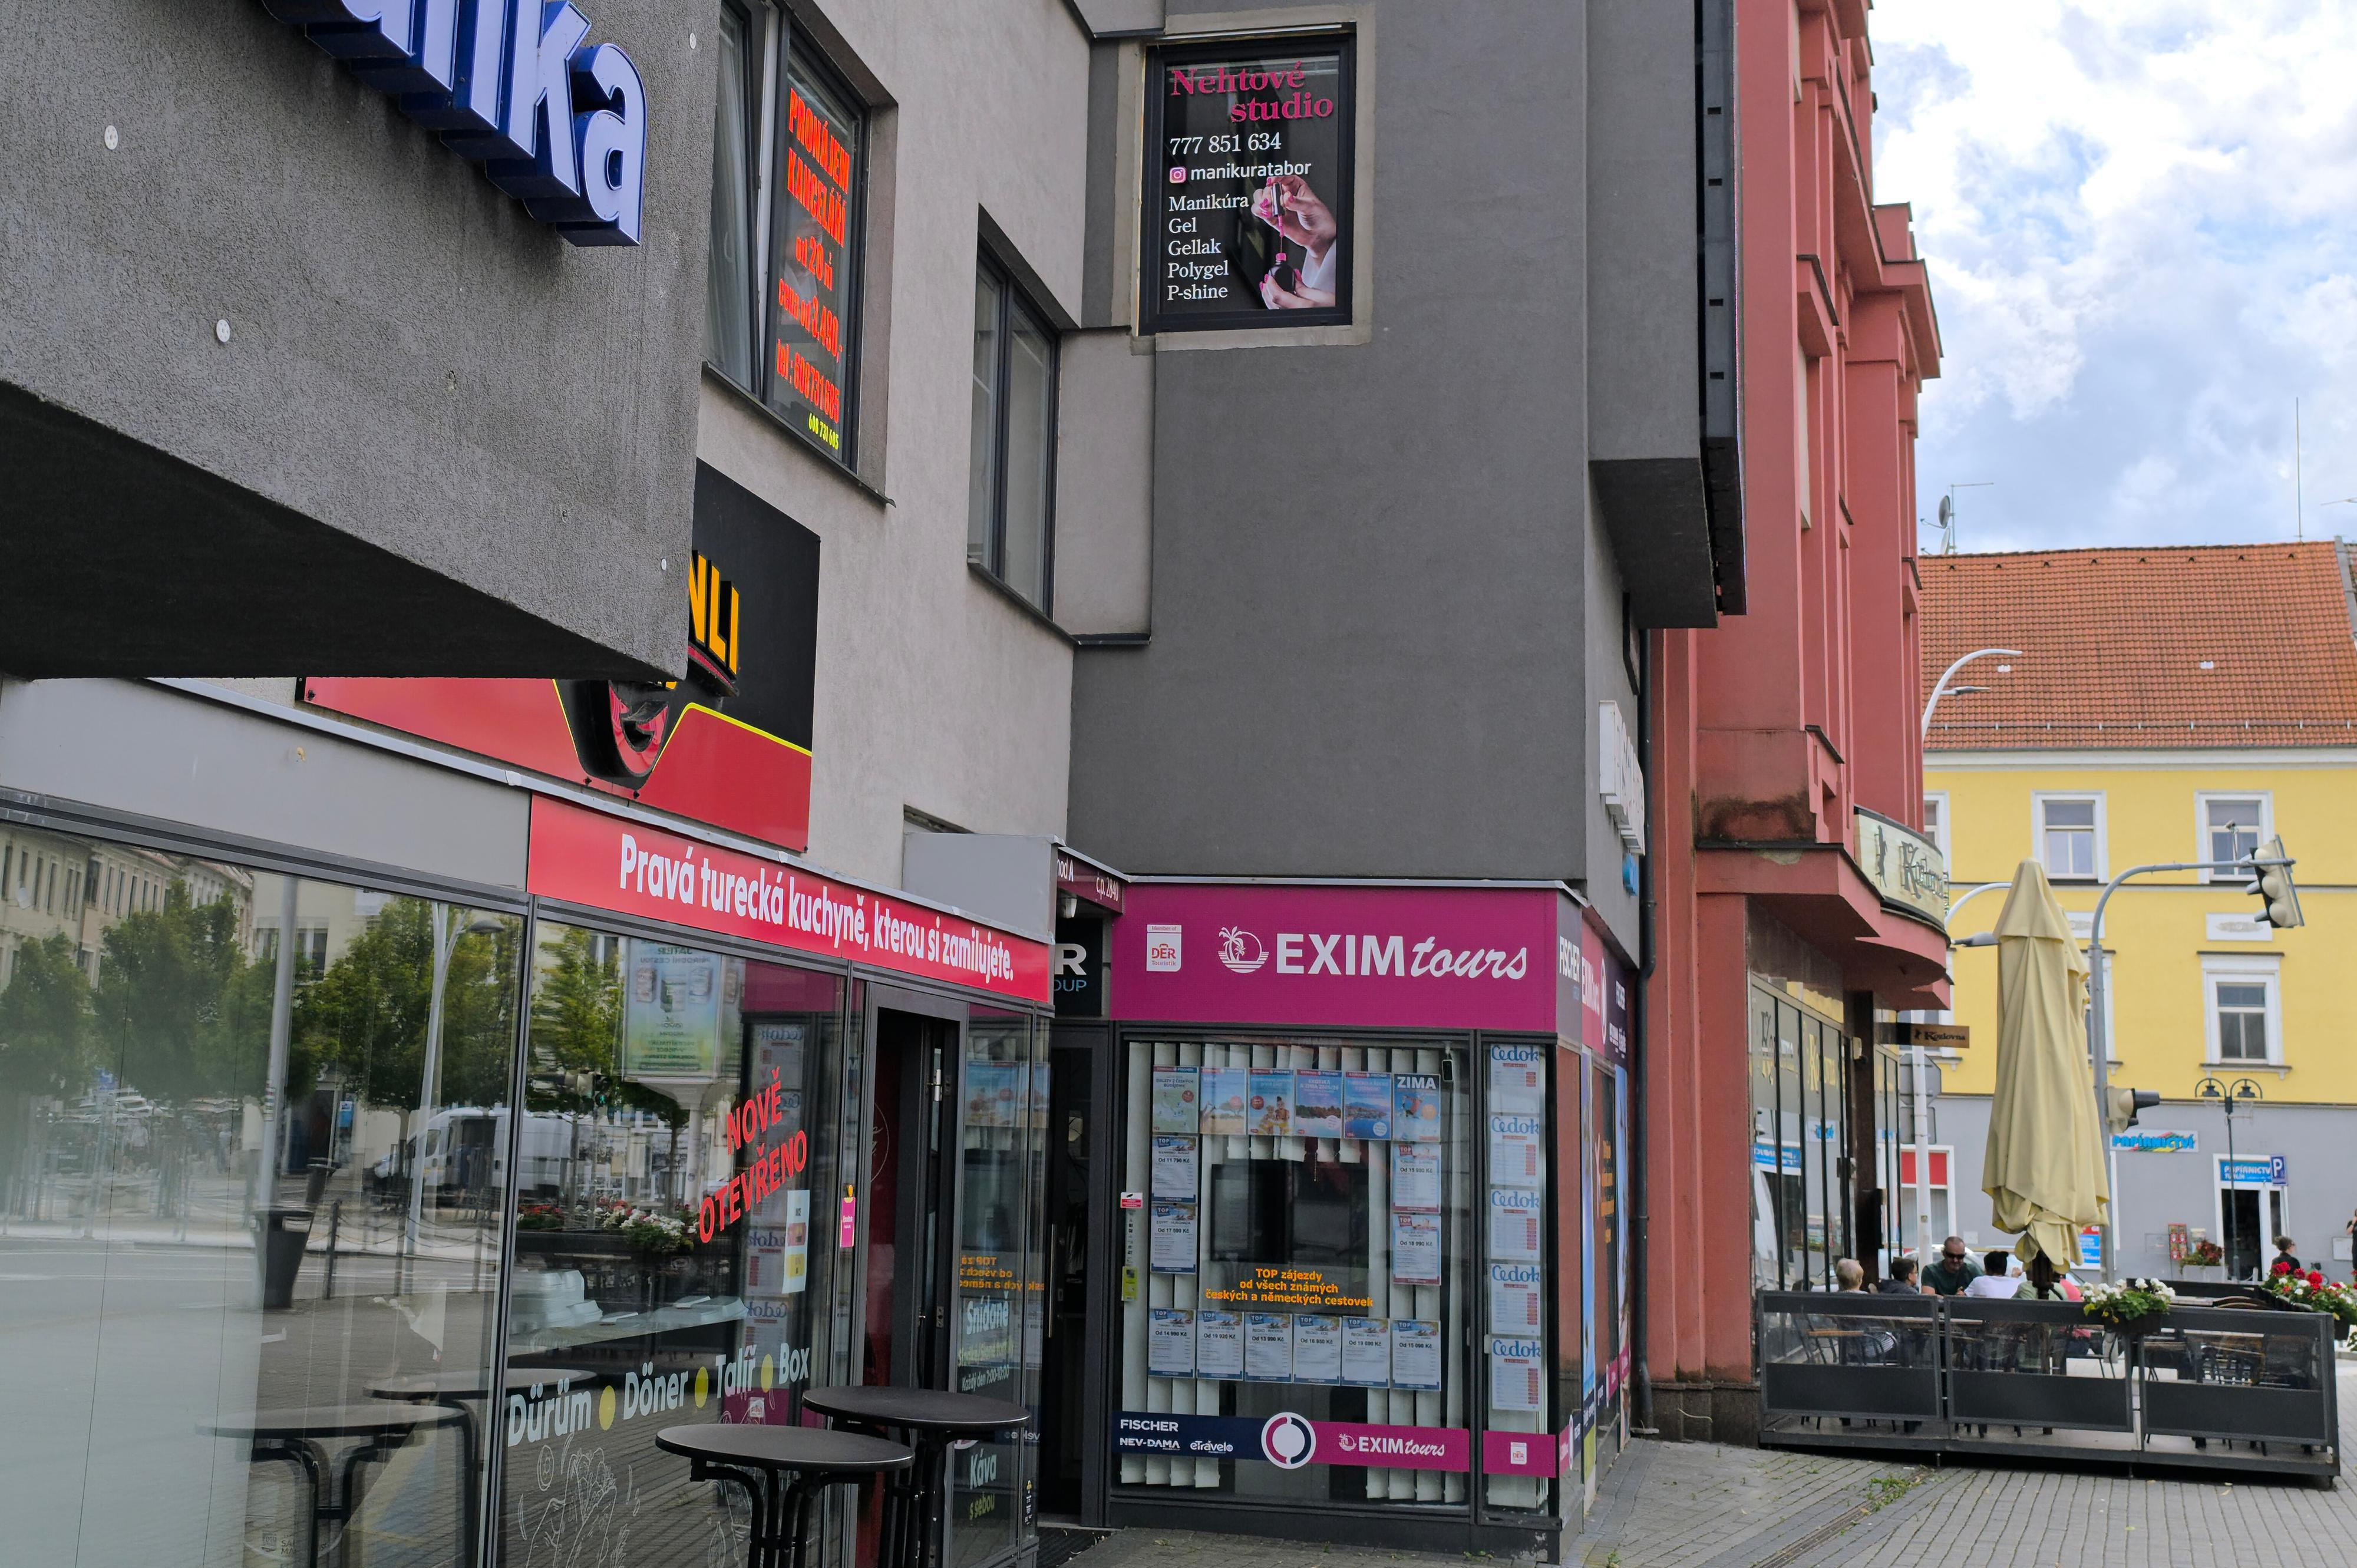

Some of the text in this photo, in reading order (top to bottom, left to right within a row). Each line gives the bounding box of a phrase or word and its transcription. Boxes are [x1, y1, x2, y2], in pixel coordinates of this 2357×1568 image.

[1171, 61, 1305, 96] Nehtové
[1231, 93, 1333, 123] studio
[788, 87, 850, 195] PRONÁJEM
[1170, 132, 1281, 156] 777 851 634
[1191, 160, 1312, 180] manikuratabor
[787, 147, 846, 248] KANCELÁŘÍ
[1168, 193, 1249, 212] Manikúra
[1168, 217, 1197, 233] Gel
[795, 236, 808, 269] od
[808, 236, 823, 281] 20
[1167, 240, 1222, 256] Gellak
[1167, 260, 1229, 279] Polygel
[778, 278, 800, 321] cena
[800, 299, 811, 332] od
[1167, 285, 1229, 301] P-shine
[794, 352, 839, 424] 608731685
[808, 412, 839, 450] 608 731 685
[1068, 860, 1074, 882] A
[1105, 876, 1119, 902] 2840
[620, 833, 1015, 984] Pravá turecká kuchyně, kterou si zamilujete.
[1151, 946, 1176, 959] DER
[1559, 935, 1580, 983] FISCHER
[1397, 1076, 1437, 1090] ZIMA
[727, 1066, 783, 1155] NOVĚ
[2112, 1133, 2194, 1149] PAPÍRNICTVÍ
[2273, 1158, 2283, 1177] P
[699, 1130, 807, 1243] OTEVŘENO
[1239, 1280, 1339, 1295] od všech známých
[1255, 1268, 1323, 1283] TOP zájezdy
[1205, 1288, 1373, 1307] českých a německých cestovek
[966, 1291, 1009, 1336] Snídaně
[715, 1344, 757, 1399] Talíř
[778, 1342, 810, 1385] Box
[623, 1361, 688, 1420] Döner
[962, 1372, 977, 1392] Každý
[977, 1371, 986, 1388] den
[507, 1377, 592, 1447] Dürüm
[1120, 1419, 1178, 1432] FISCHER
[1120, 1437, 1181, 1449] NEV-DAMA
[970, 1447, 997, 1490] Káva
[969, 1493, 996, 1521] s sebou
